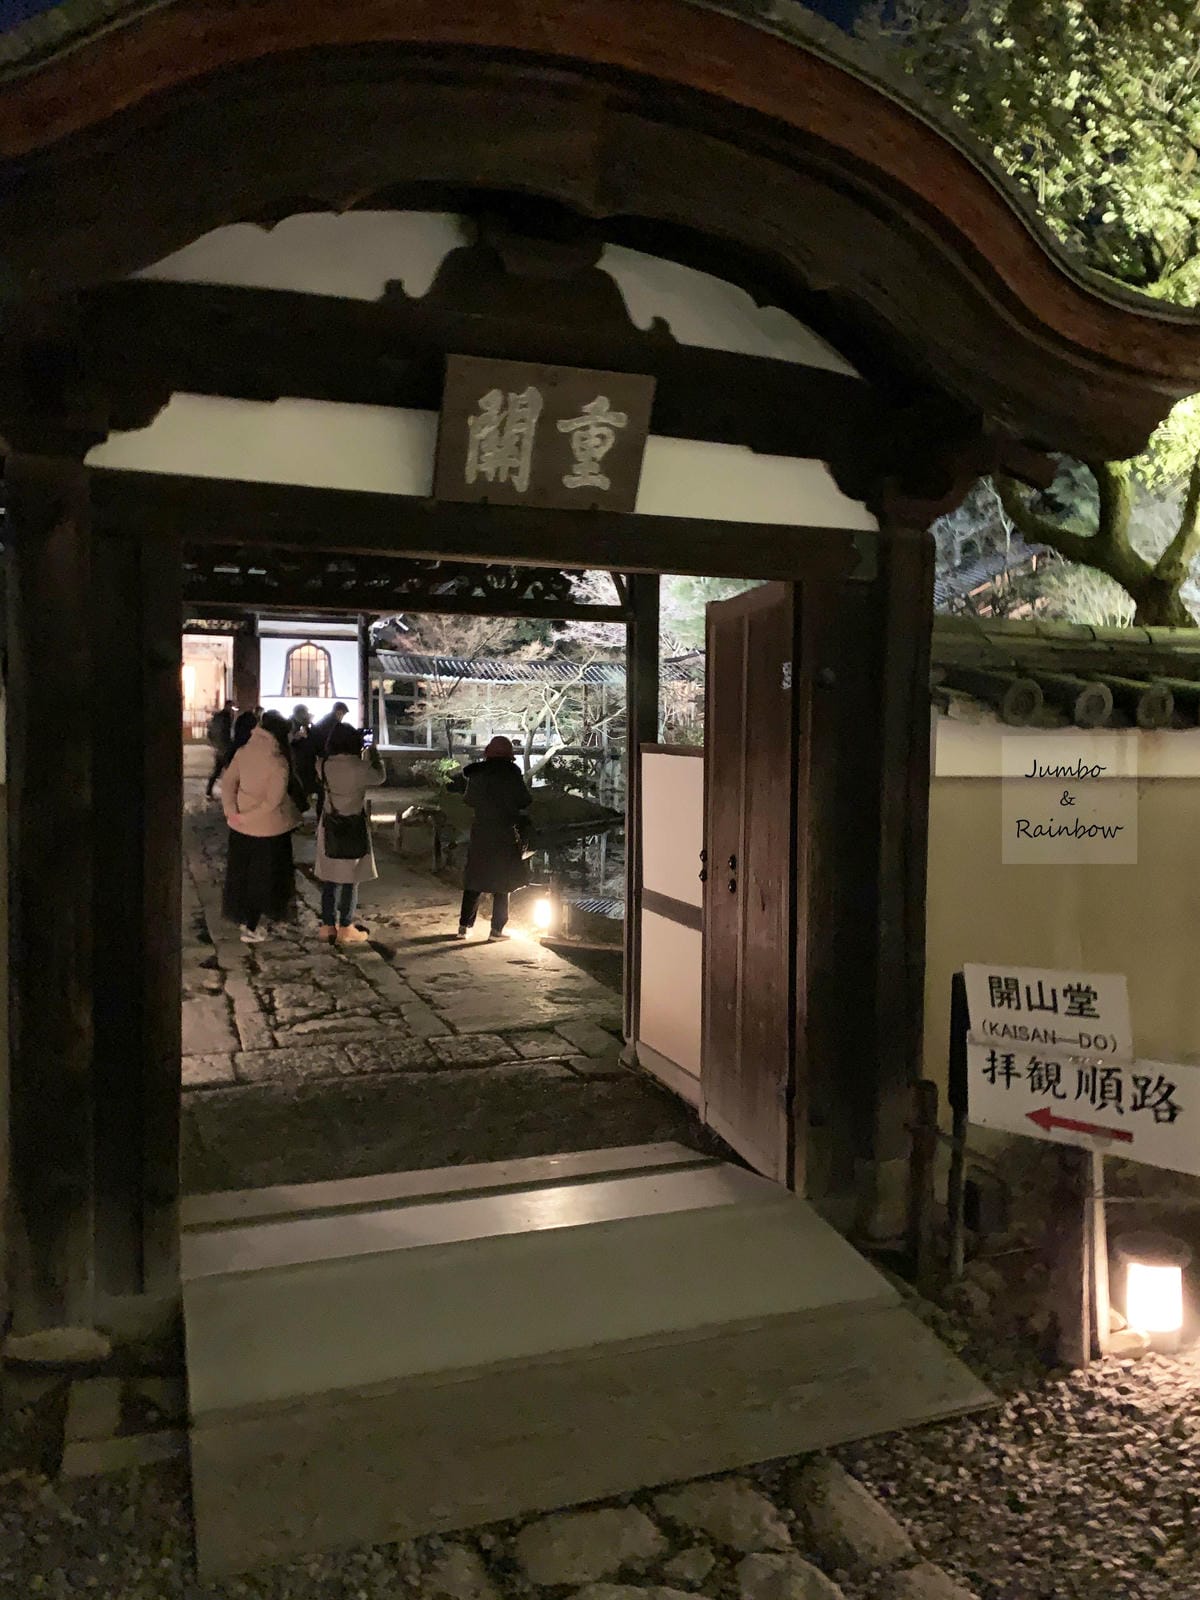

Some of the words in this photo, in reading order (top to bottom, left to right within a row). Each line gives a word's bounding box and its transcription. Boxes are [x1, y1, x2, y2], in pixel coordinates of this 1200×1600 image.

[987, 975, 1101, 1019] 開山堂
[982, 1049, 1184, 1125] 拝観順路
